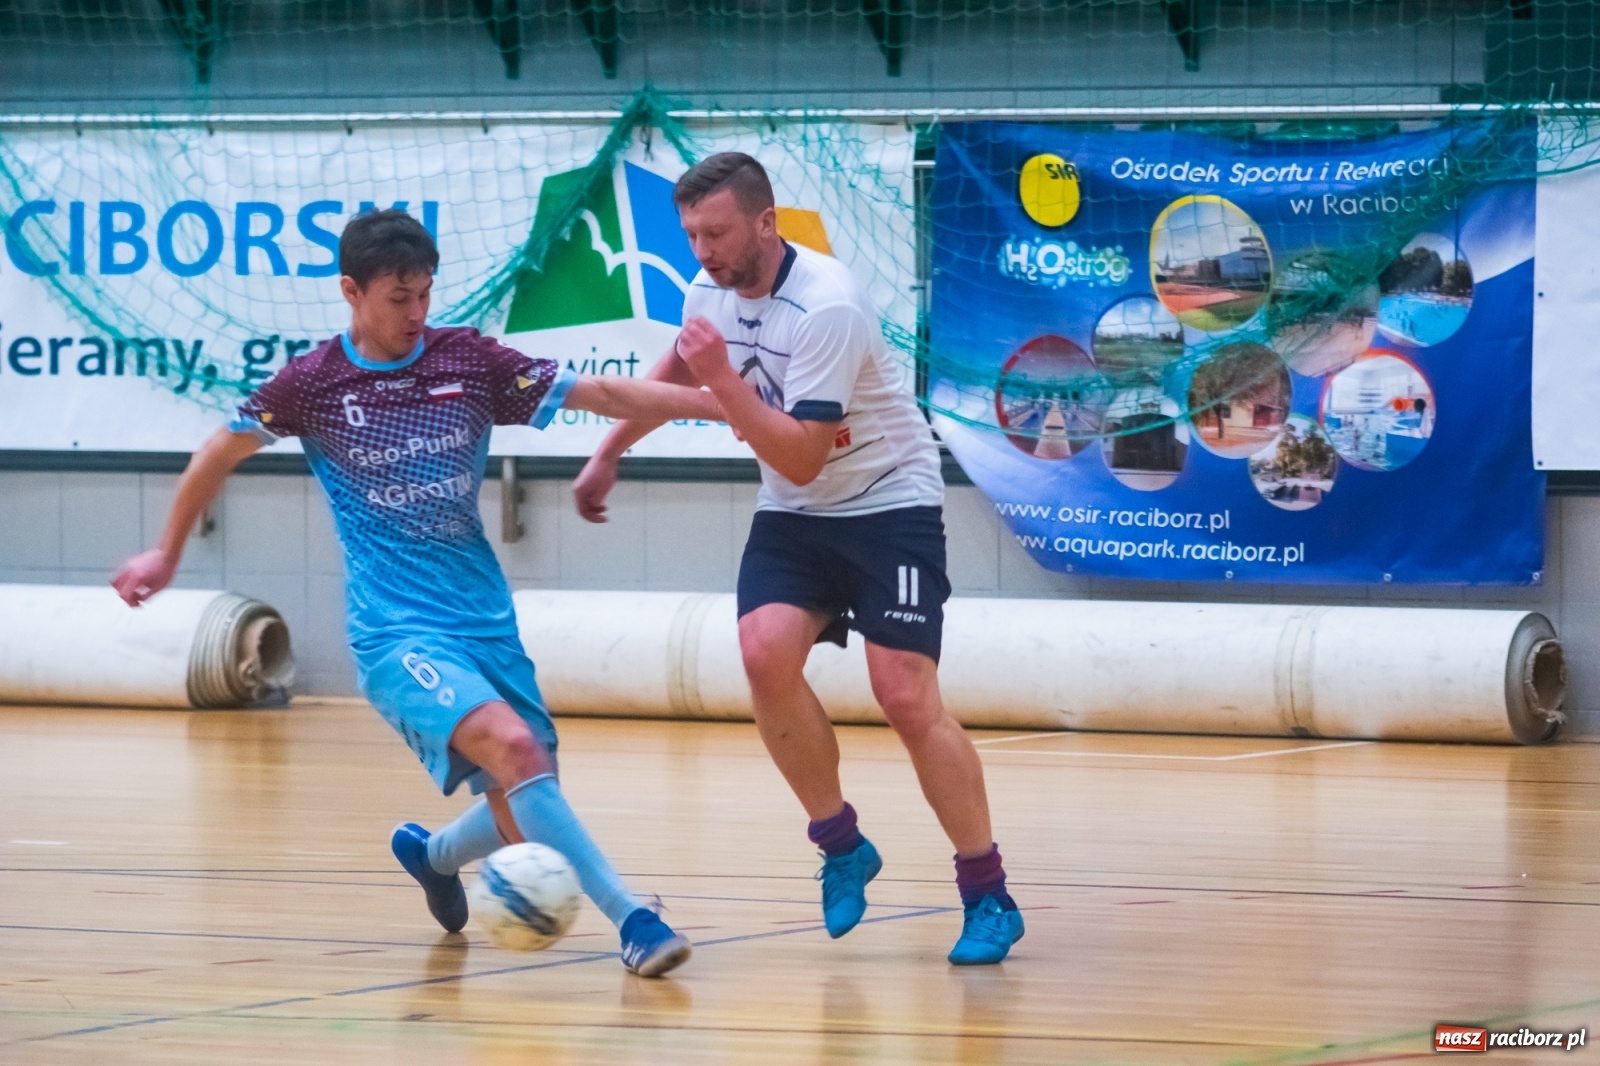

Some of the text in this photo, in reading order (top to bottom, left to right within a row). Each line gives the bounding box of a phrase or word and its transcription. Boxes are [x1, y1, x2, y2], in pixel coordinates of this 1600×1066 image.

[1111, 157, 1221, 183] Ośrodek
[1229, 162, 1314, 187] Sportu
[1320, 162, 1330, 181] i
[1290, 199, 1314, 215] w
[342, 394, 365, 427] 6
[898, 565, 919, 607] 11
[402, 651, 441, 691] 6
